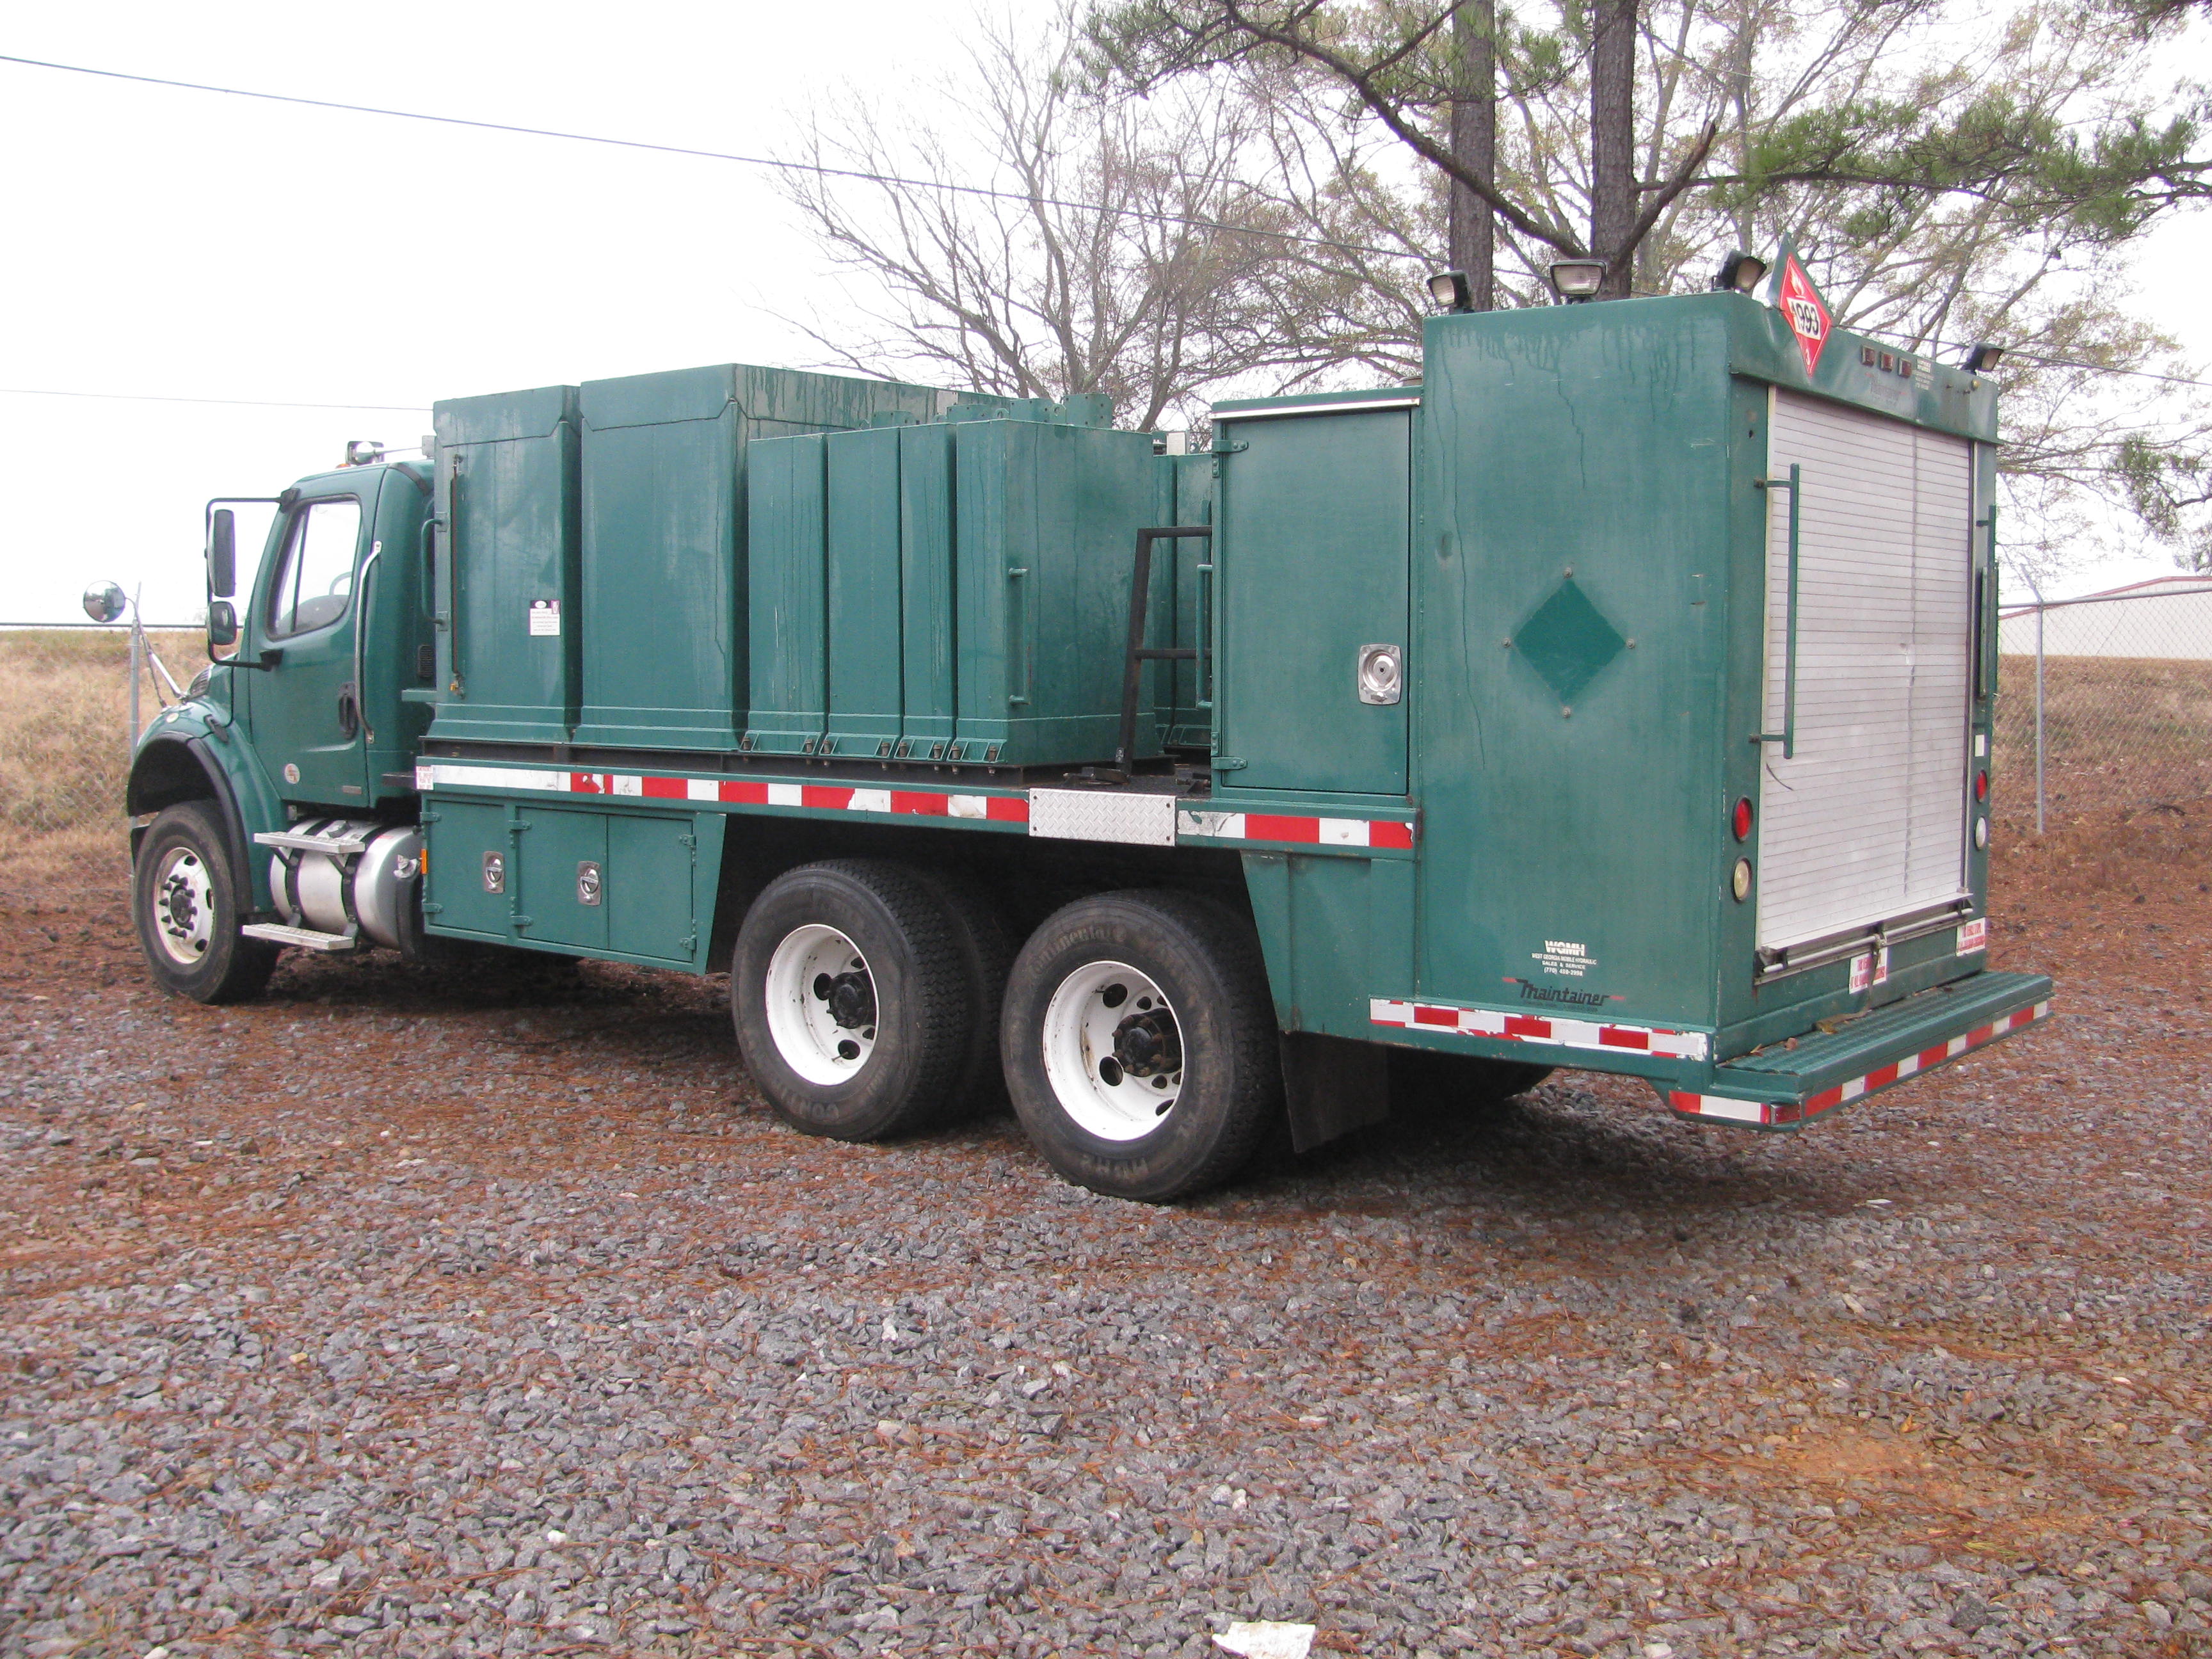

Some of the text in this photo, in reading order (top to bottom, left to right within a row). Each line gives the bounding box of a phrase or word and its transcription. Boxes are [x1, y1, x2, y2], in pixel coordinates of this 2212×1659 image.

[1790, 300, 1820, 336] 1993
[1804, 348, 1811, 365] 3
[1544, 940, 1585, 956] WGMH
